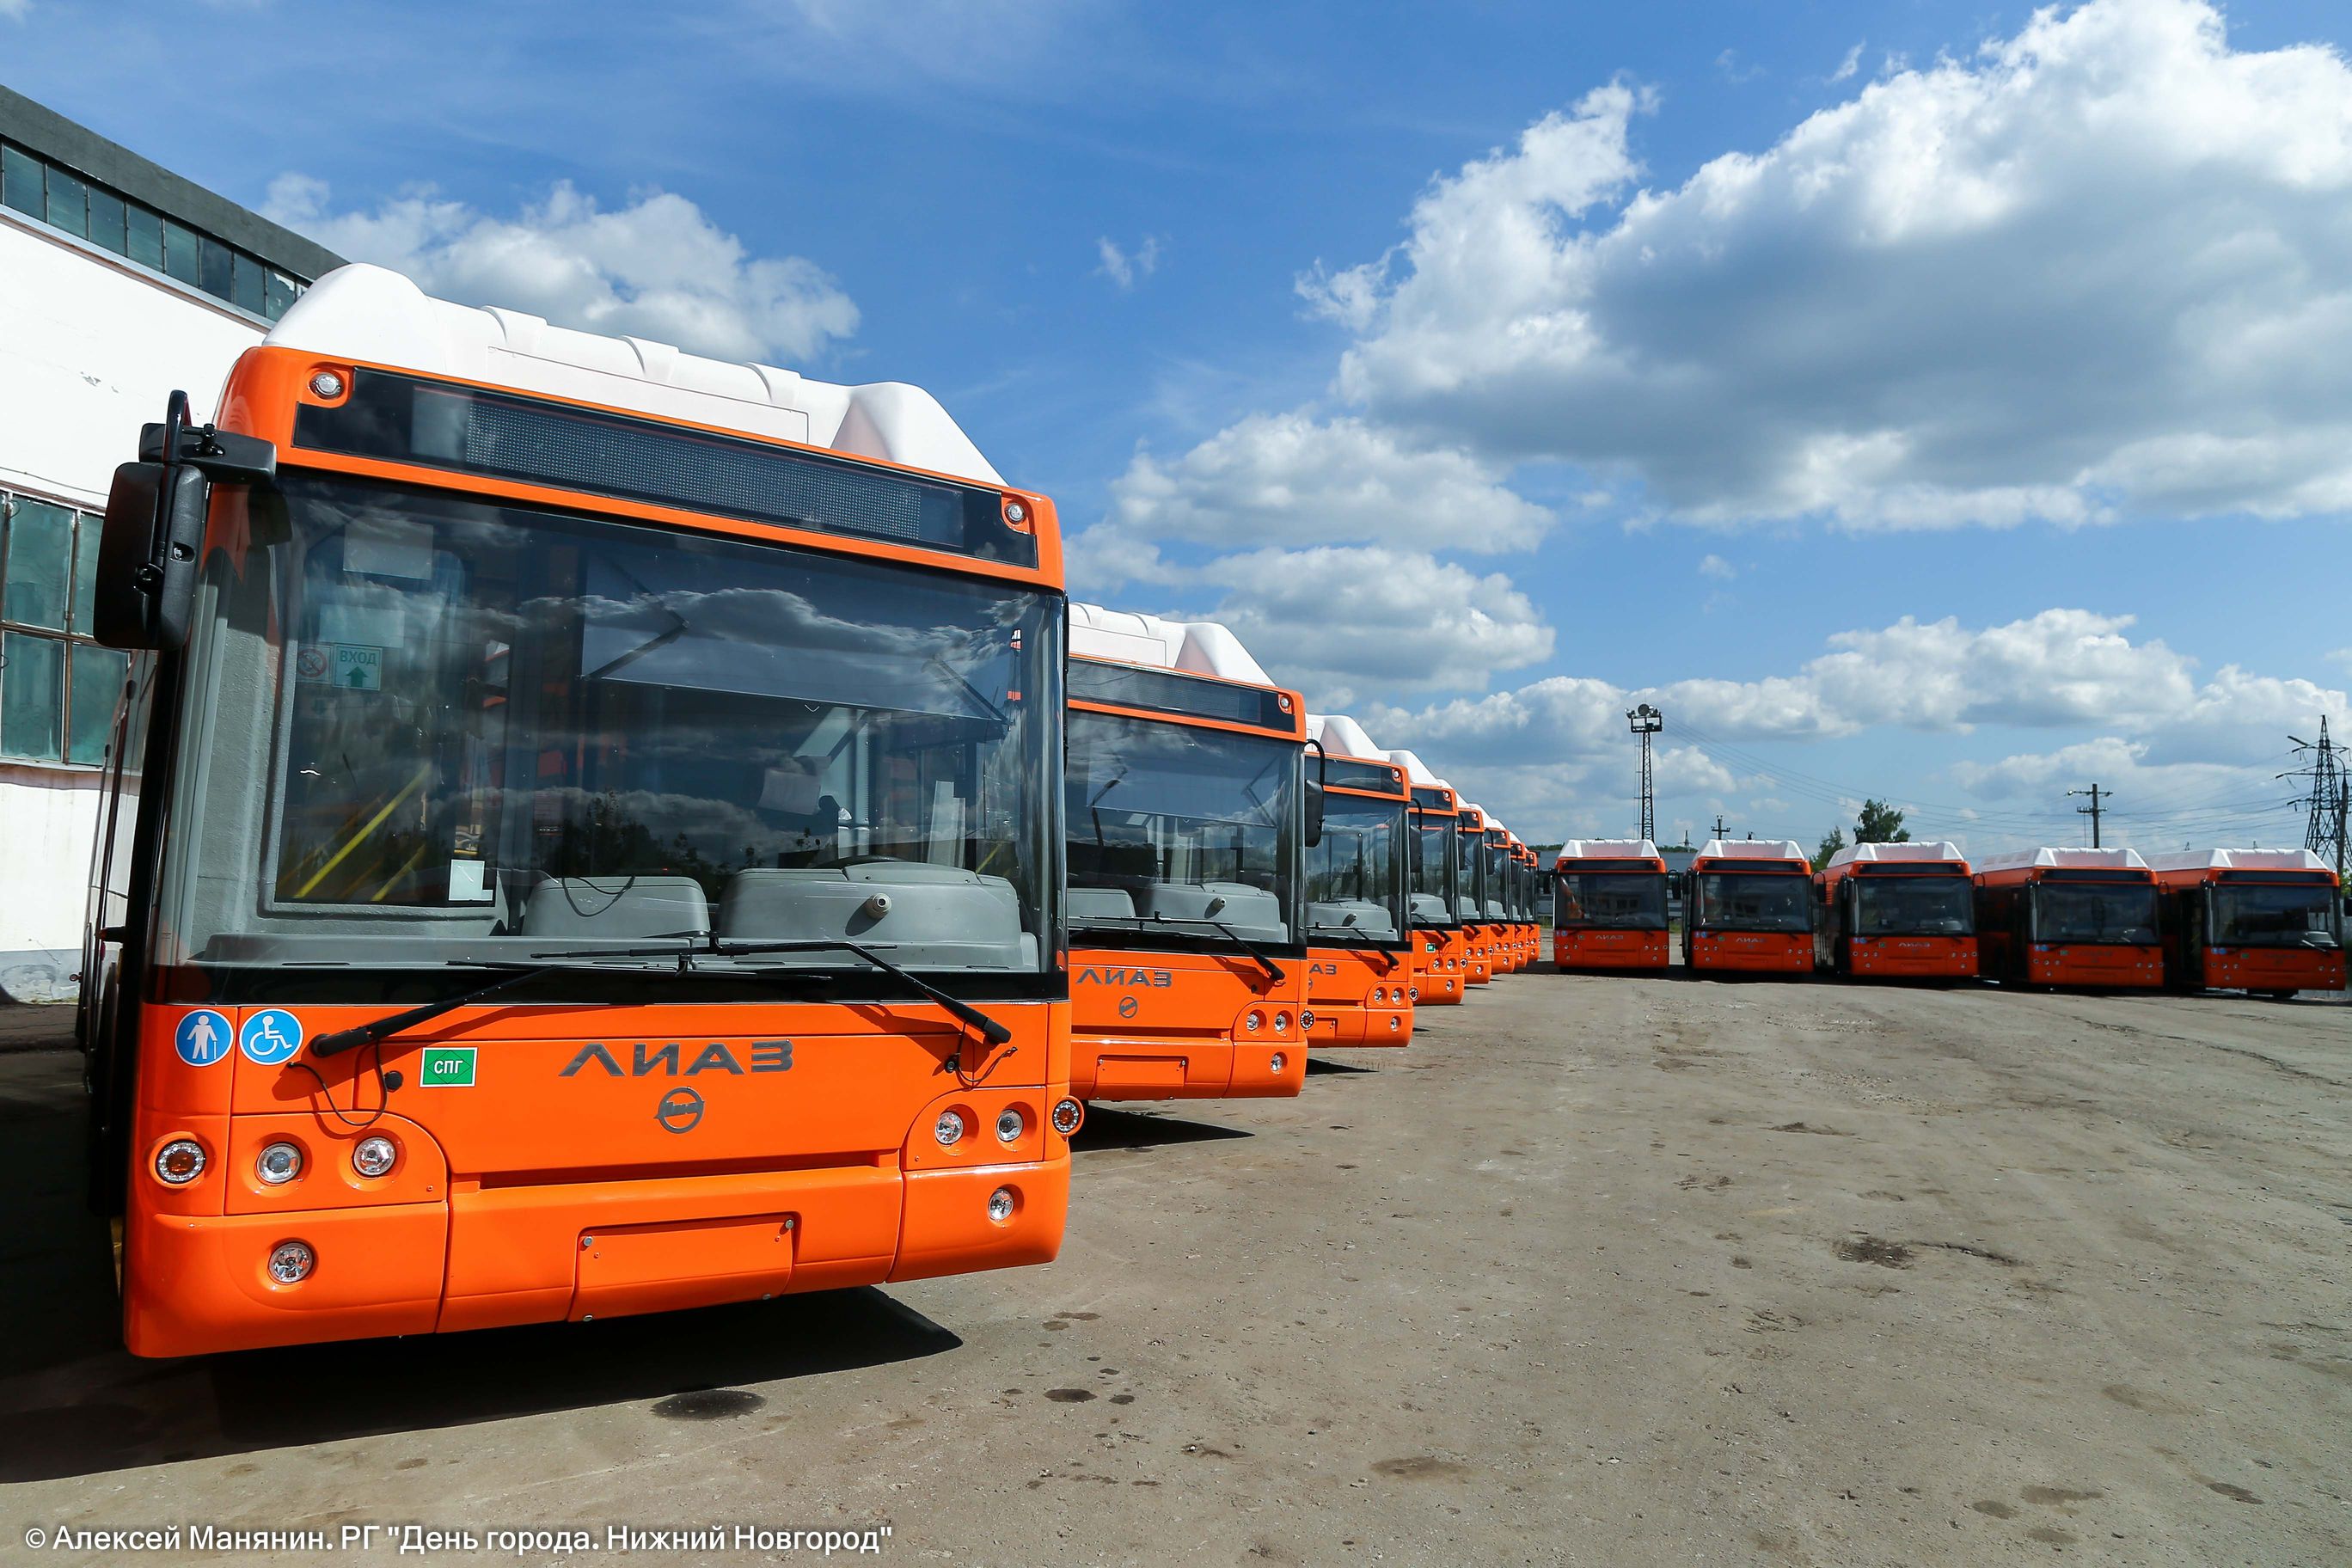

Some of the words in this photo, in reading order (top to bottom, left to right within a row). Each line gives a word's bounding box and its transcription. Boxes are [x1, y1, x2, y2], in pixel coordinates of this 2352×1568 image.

[340, 650, 377, 666] ВХОД
[1075, 967, 1173, 988] ЛИАЗ
[1308, 963, 1338, 976] АЗ
[558, 1040, 794, 1077] ЛИАЗ
[433, 1059, 464, 1075] СПГ
